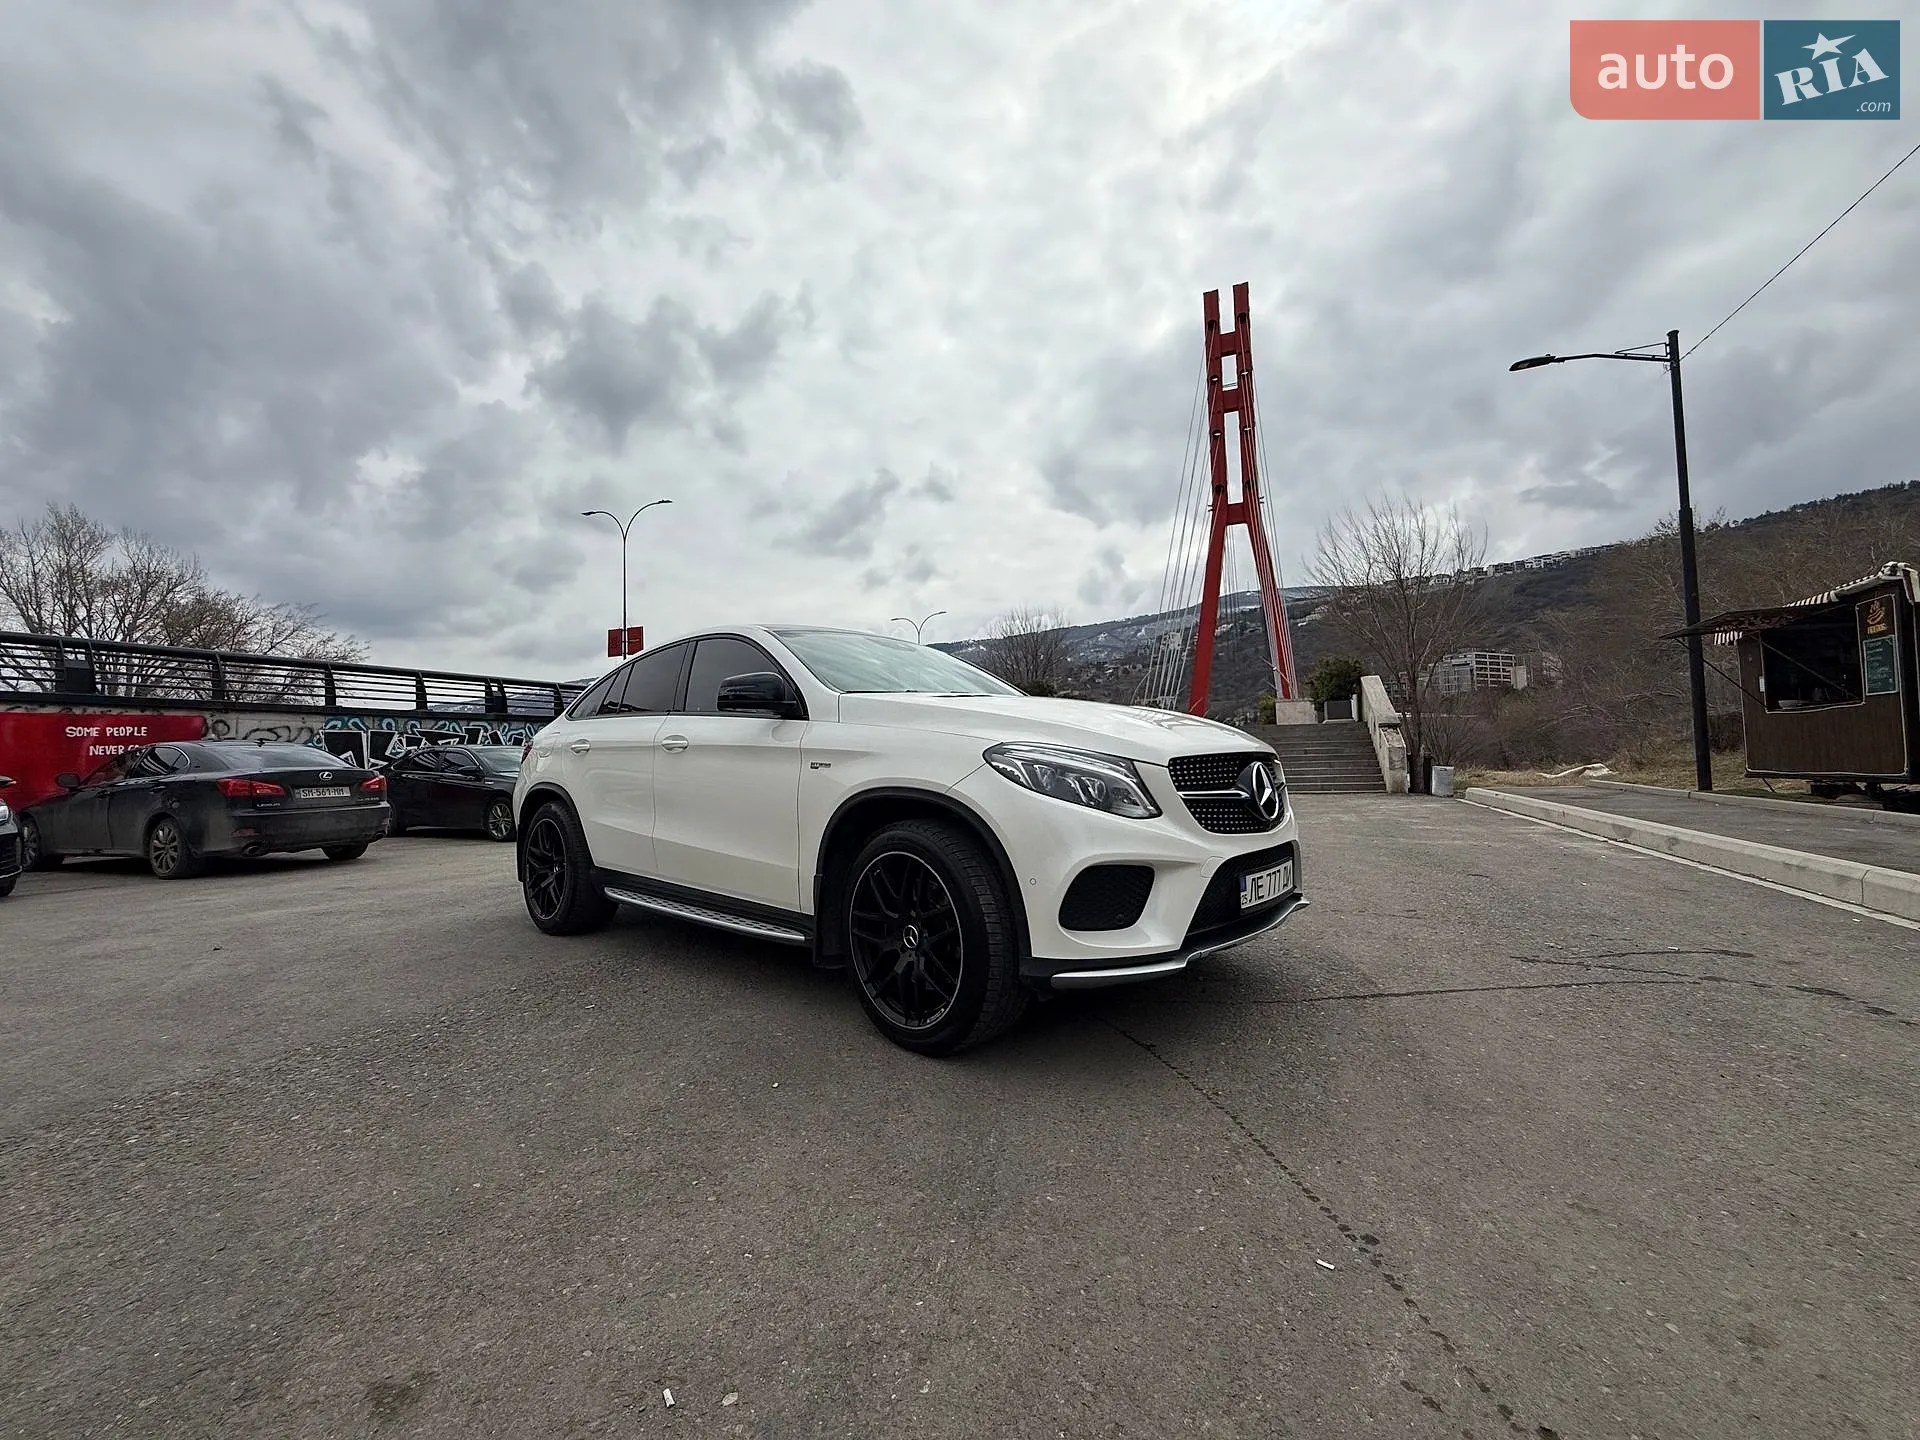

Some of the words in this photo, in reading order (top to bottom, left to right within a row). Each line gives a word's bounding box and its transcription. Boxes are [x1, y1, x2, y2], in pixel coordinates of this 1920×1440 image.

[65, 726, 101, 738] SOME
[106, 726, 148, 737] PEOPLE
[89, 745, 125, 756] NEVER
[1266, 868, 1281, 896] 777
